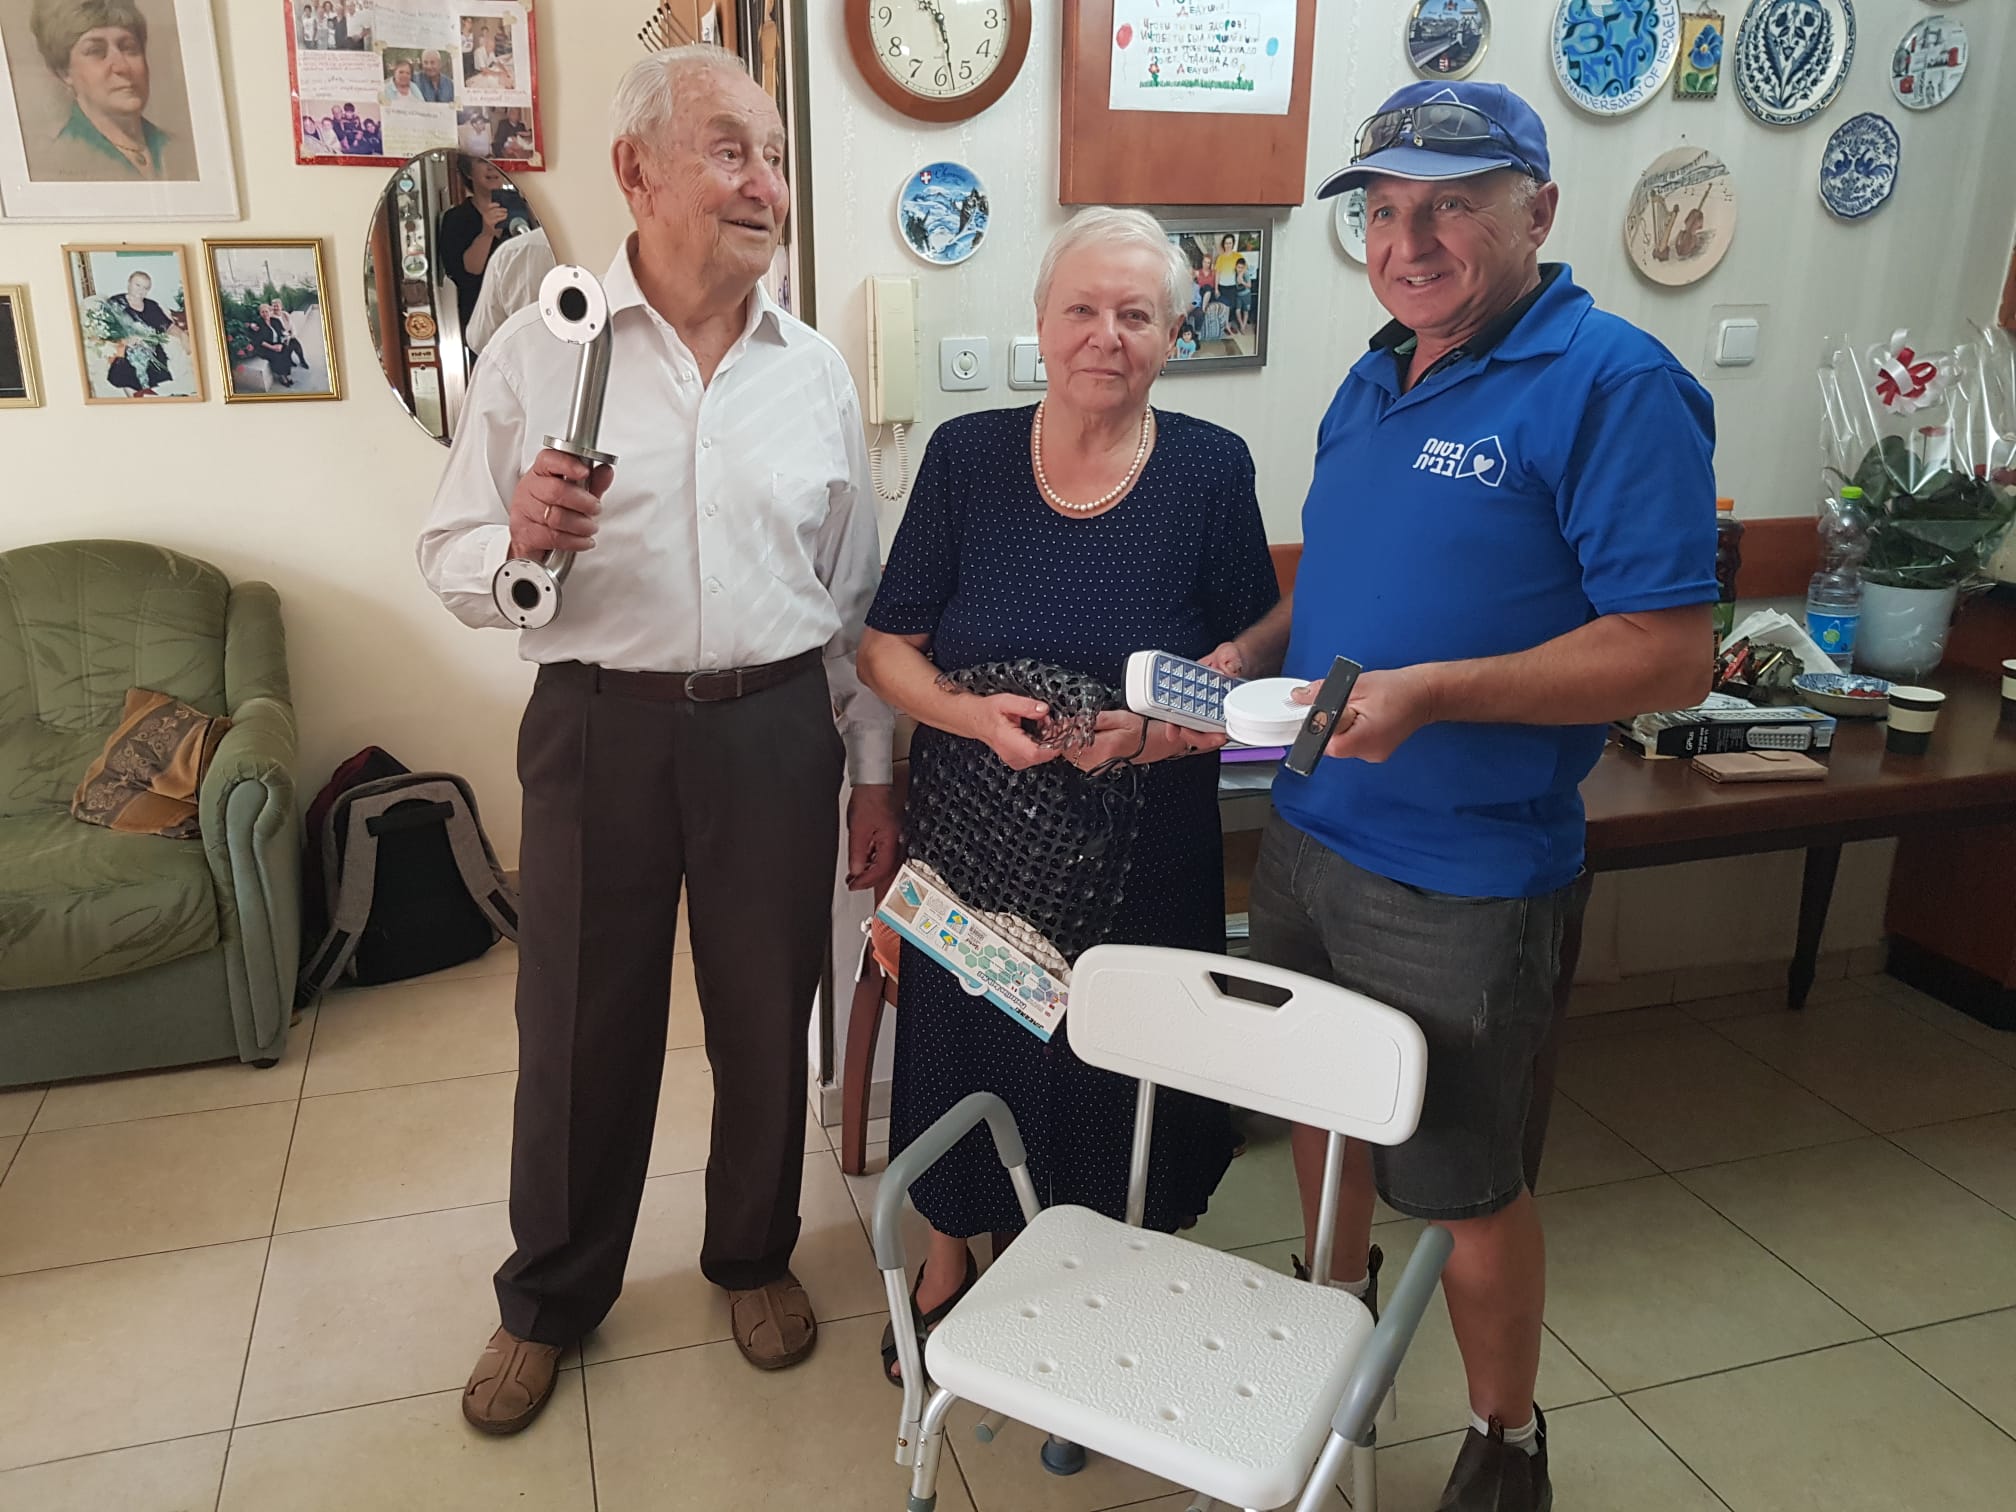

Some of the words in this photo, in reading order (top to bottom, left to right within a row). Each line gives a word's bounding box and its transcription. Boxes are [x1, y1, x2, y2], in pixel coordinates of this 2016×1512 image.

[878, 6, 892, 28] 9
[984, 8, 998, 29] 3
[888, 36, 902, 57] 8
[976, 39, 991, 58] 4
[908, 58, 923, 78] 7
[934, 64, 947, 87] 6
[959, 60, 972, 80] 5
[1644, 67, 1661, 88] OF
[1422, 437, 1465, 460] בטוח
[1412, 453, 1456, 477] בבית
